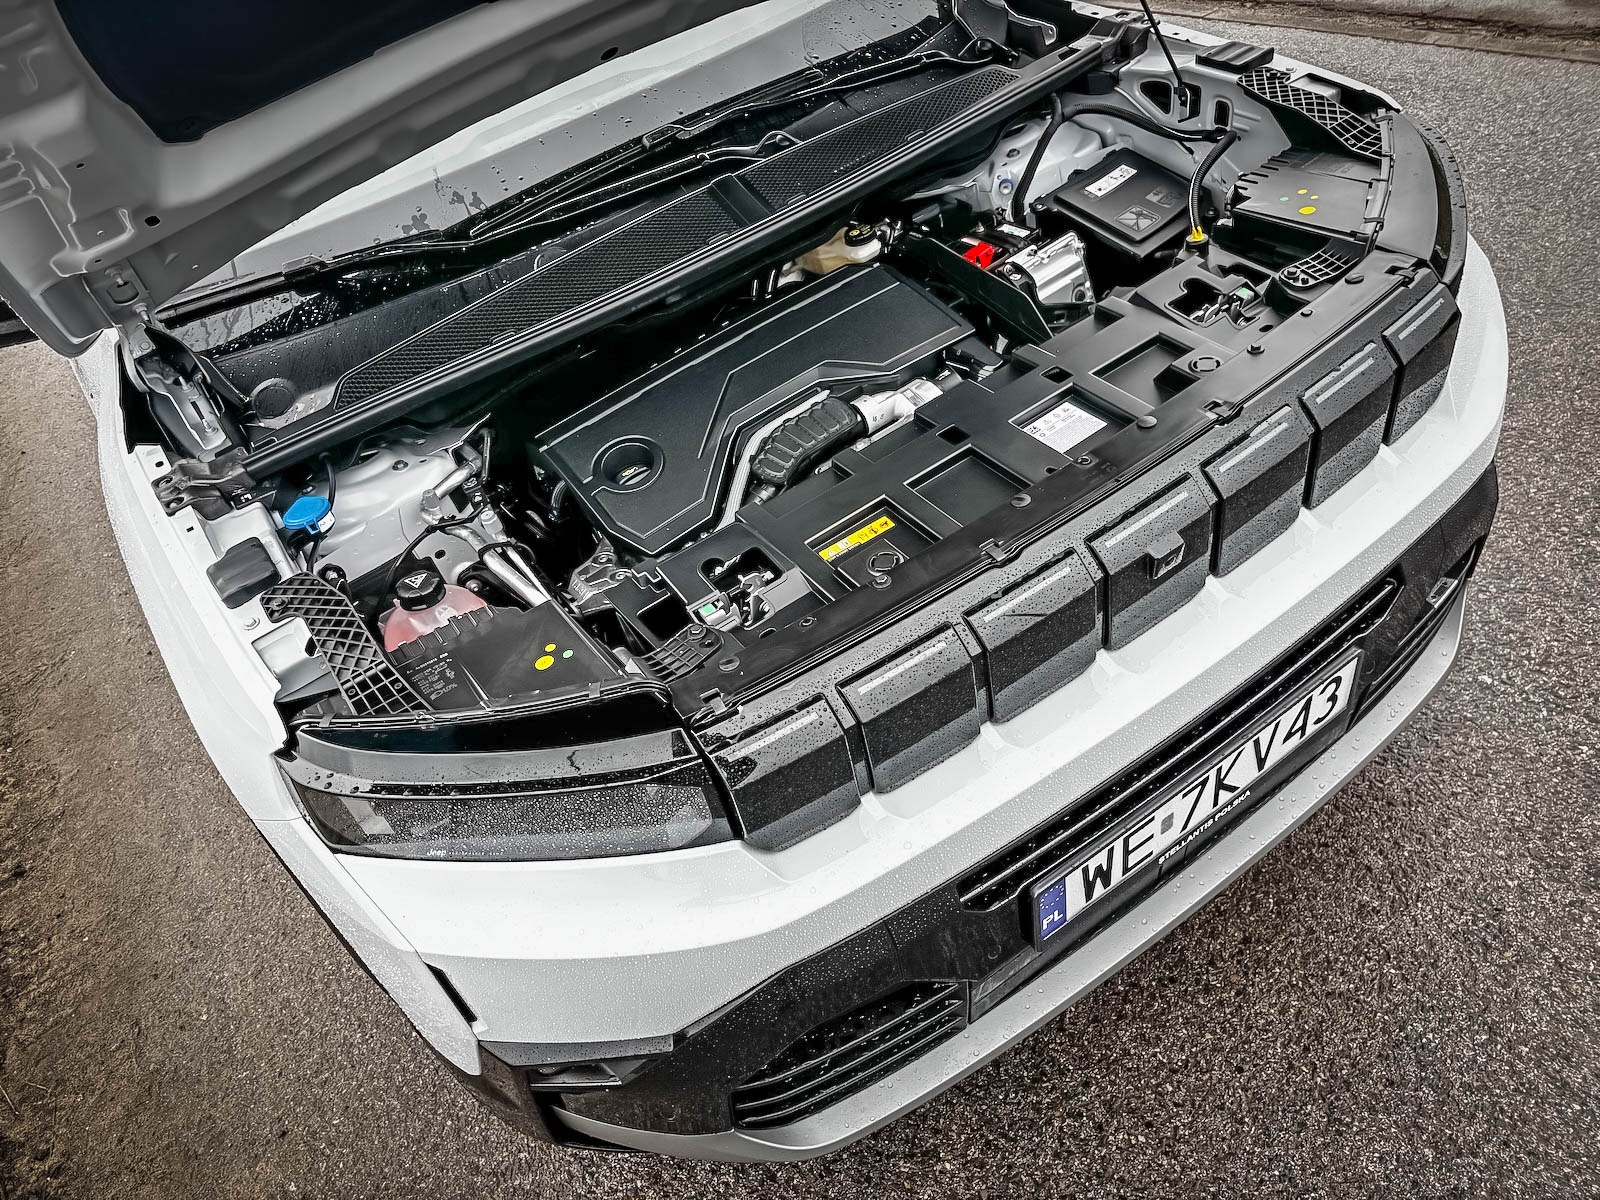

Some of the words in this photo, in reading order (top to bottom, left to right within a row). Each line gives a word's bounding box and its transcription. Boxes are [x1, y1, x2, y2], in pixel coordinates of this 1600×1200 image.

[1081, 815, 1155, 903] WE
[1180, 675, 1343, 834] 7KV43
[1158, 818, 1214, 865] STELLANTIS
[1214, 789, 1251, 822] POLSKA
[1042, 908, 1064, 930] PL
